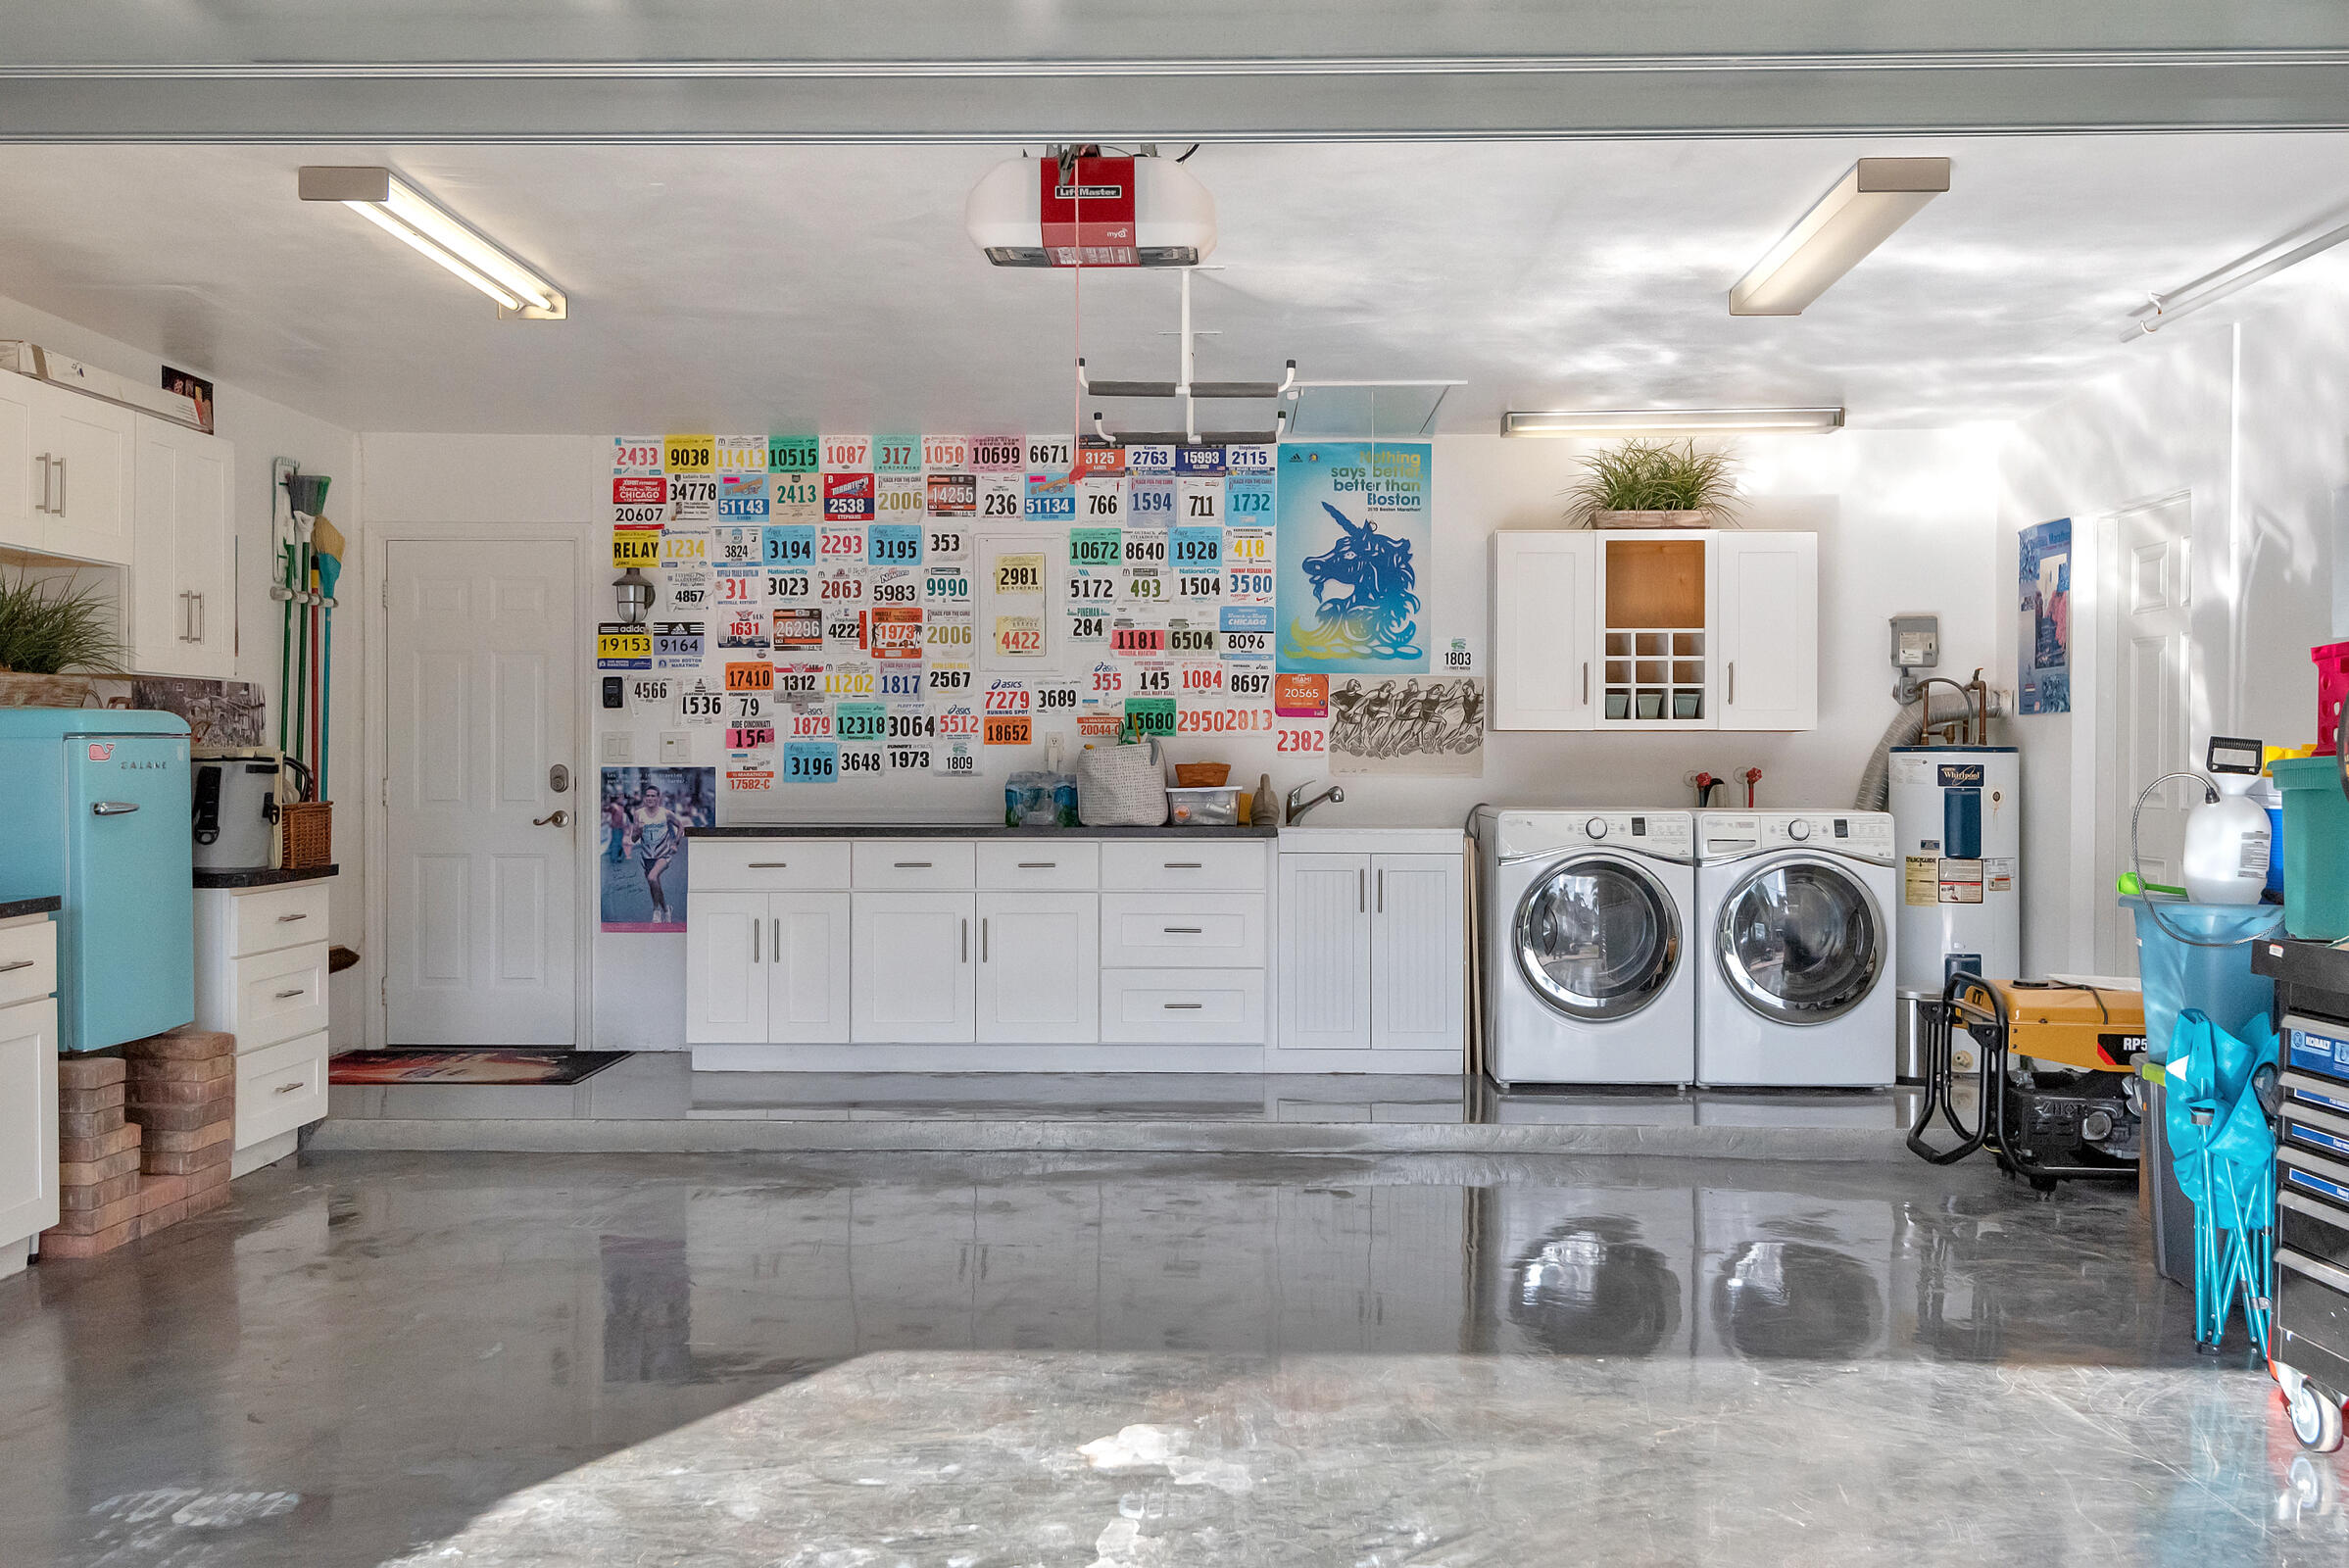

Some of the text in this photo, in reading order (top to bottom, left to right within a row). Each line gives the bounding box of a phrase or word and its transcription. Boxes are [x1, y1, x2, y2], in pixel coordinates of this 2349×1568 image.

[616, 448, 658, 466] 2433
[671, 449, 709, 466] 9038
[717, 449, 766, 467] 11413
[769, 449, 816, 466] 10515
[827, 446, 866, 464] 1087
[882, 447, 911, 465] 317
[925, 446, 964, 464] 1058
[973, 447, 1020, 464] 10699
[1029, 445, 1069, 464] 6671
[1085, 452, 1115, 465] 3125
[1132, 452, 1168, 466] 2763
[1183, 452, 1220, 465] 15993
[1231, 452, 1268, 466] 2115
[1359, 451, 1421, 467] Nothing
[828, 475, 834, 484] B
[1331, 466, 1424, 481] says better,
[669, 483, 717, 501] 34778
[777, 485, 817, 504] 2413
[1334, 479, 1421, 492] better than
[878, 492, 923, 511] 2006
[933, 486, 974, 504] 14255
[1132, 492, 1172, 512] 1594
[1233, 493, 1271, 512] 1732
[1367, 492, 1421, 506] Boston
[719, 500, 764, 514] 51143
[829, 499, 865, 514] 2538
[984, 494, 1017, 515] 236
[1026, 498, 1070, 514] 51134
[1089, 495, 1118, 514] 766
[1189, 496, 1215, 517] 711
[615, 508, 663, 522] 20607
[613, 542, 660, 559] RELAY
[666, 539, 705, 558] 1234
[725, 545, 748, 559] 3824
[769, 540, 811, 560] 3194
[821, 535, 862, 555] 2293
[875, 540, 917, 559] 3195
[931, 534, 960, 553] 353
[1071, 541, 1119, 560] 10672
[1125, 542, 1165, 561] 8640
[1176, 541, 1218, 560] 1928
[1233, 539, 1265, 558] 418
[1000, 567, 1039, 586] 2981
[1230, 574, 1273, 594] 3580
[725, 578, 748, 600] 31
[767, 577, 808, 596] 3023
[821, 579, 862, 600] 2863
[873, 585, 915, 602] 5983
[926, 578, 968, 597] 9990
[1070, 579, 1113, 598] 5172
[1130, 579, 1161, 598] 493
[1180, 577, 1221, 596] 1504
[674, 590, 705, 603] 4857
[729, 622, 759, 636] 1631
[776, 621, 819, 637] 26296
[880, 625, 915, 640] 1973
[927, 626, 972, 644] 2006
[1073, 618, 1103, 637] 284
[601, 638, 651, 652] 19153
[660, 639, 699, 652] 9164
[1001, 632, 1040, 650] 4422
[1117, 631, 1157, 649] 1181
[1171, 631, 1213, 650] 6504
[1228, 634, 1265, 650] 8096
[1444, 652, 1472, 665] 1803
[729, 670, 770, 687] 17410
[782, 675, 816, 691] 1312
[824, 674, 875, 693] 11202
[881, 675, 921, 695] 1817
[930, 671, 971, 688] 2567
[1093, 673, 1122, 691] 355
[1140, 672, 1170, 690] 145
[1182, 670, 1222, 689] 1084
[1231, 674, 1270, 693] 8697
[634, 682, 667, 699] 4566
[1038, 690, 1077, 708] 3689
[1285, 688, 1319, 699] 20565
[682, 697, 721, 715] 1536
[740, 698, 759, 716] 79
[985, 691, 1030, 709] 7279
[793, 716, 831, 735] 1879
[838, 716, 886, 735] 12318
[888, 716, 935, 737] 3064
[940, 715, 979, 733] 5512
[1127, 712, 1174, 730] 15680
[1177, 710, 1225, 733] 2950
[1226, 709, 1273, 731] 2813
[987, 725, 1028, 742] 18652
[1277, 730, 1325, 752] 2382
[791, 758, 832, 775] 3196
[841, 753, 881, 771] 3648
[889, 751, 930, 768] 1973
[947, 757, 973, 769] 1809
[1943, 770, 1980, 780] Whirlpool
[730, 779, 770, 790] 17582-C
[2305, 1035, 2331, 1051] KOBALT
